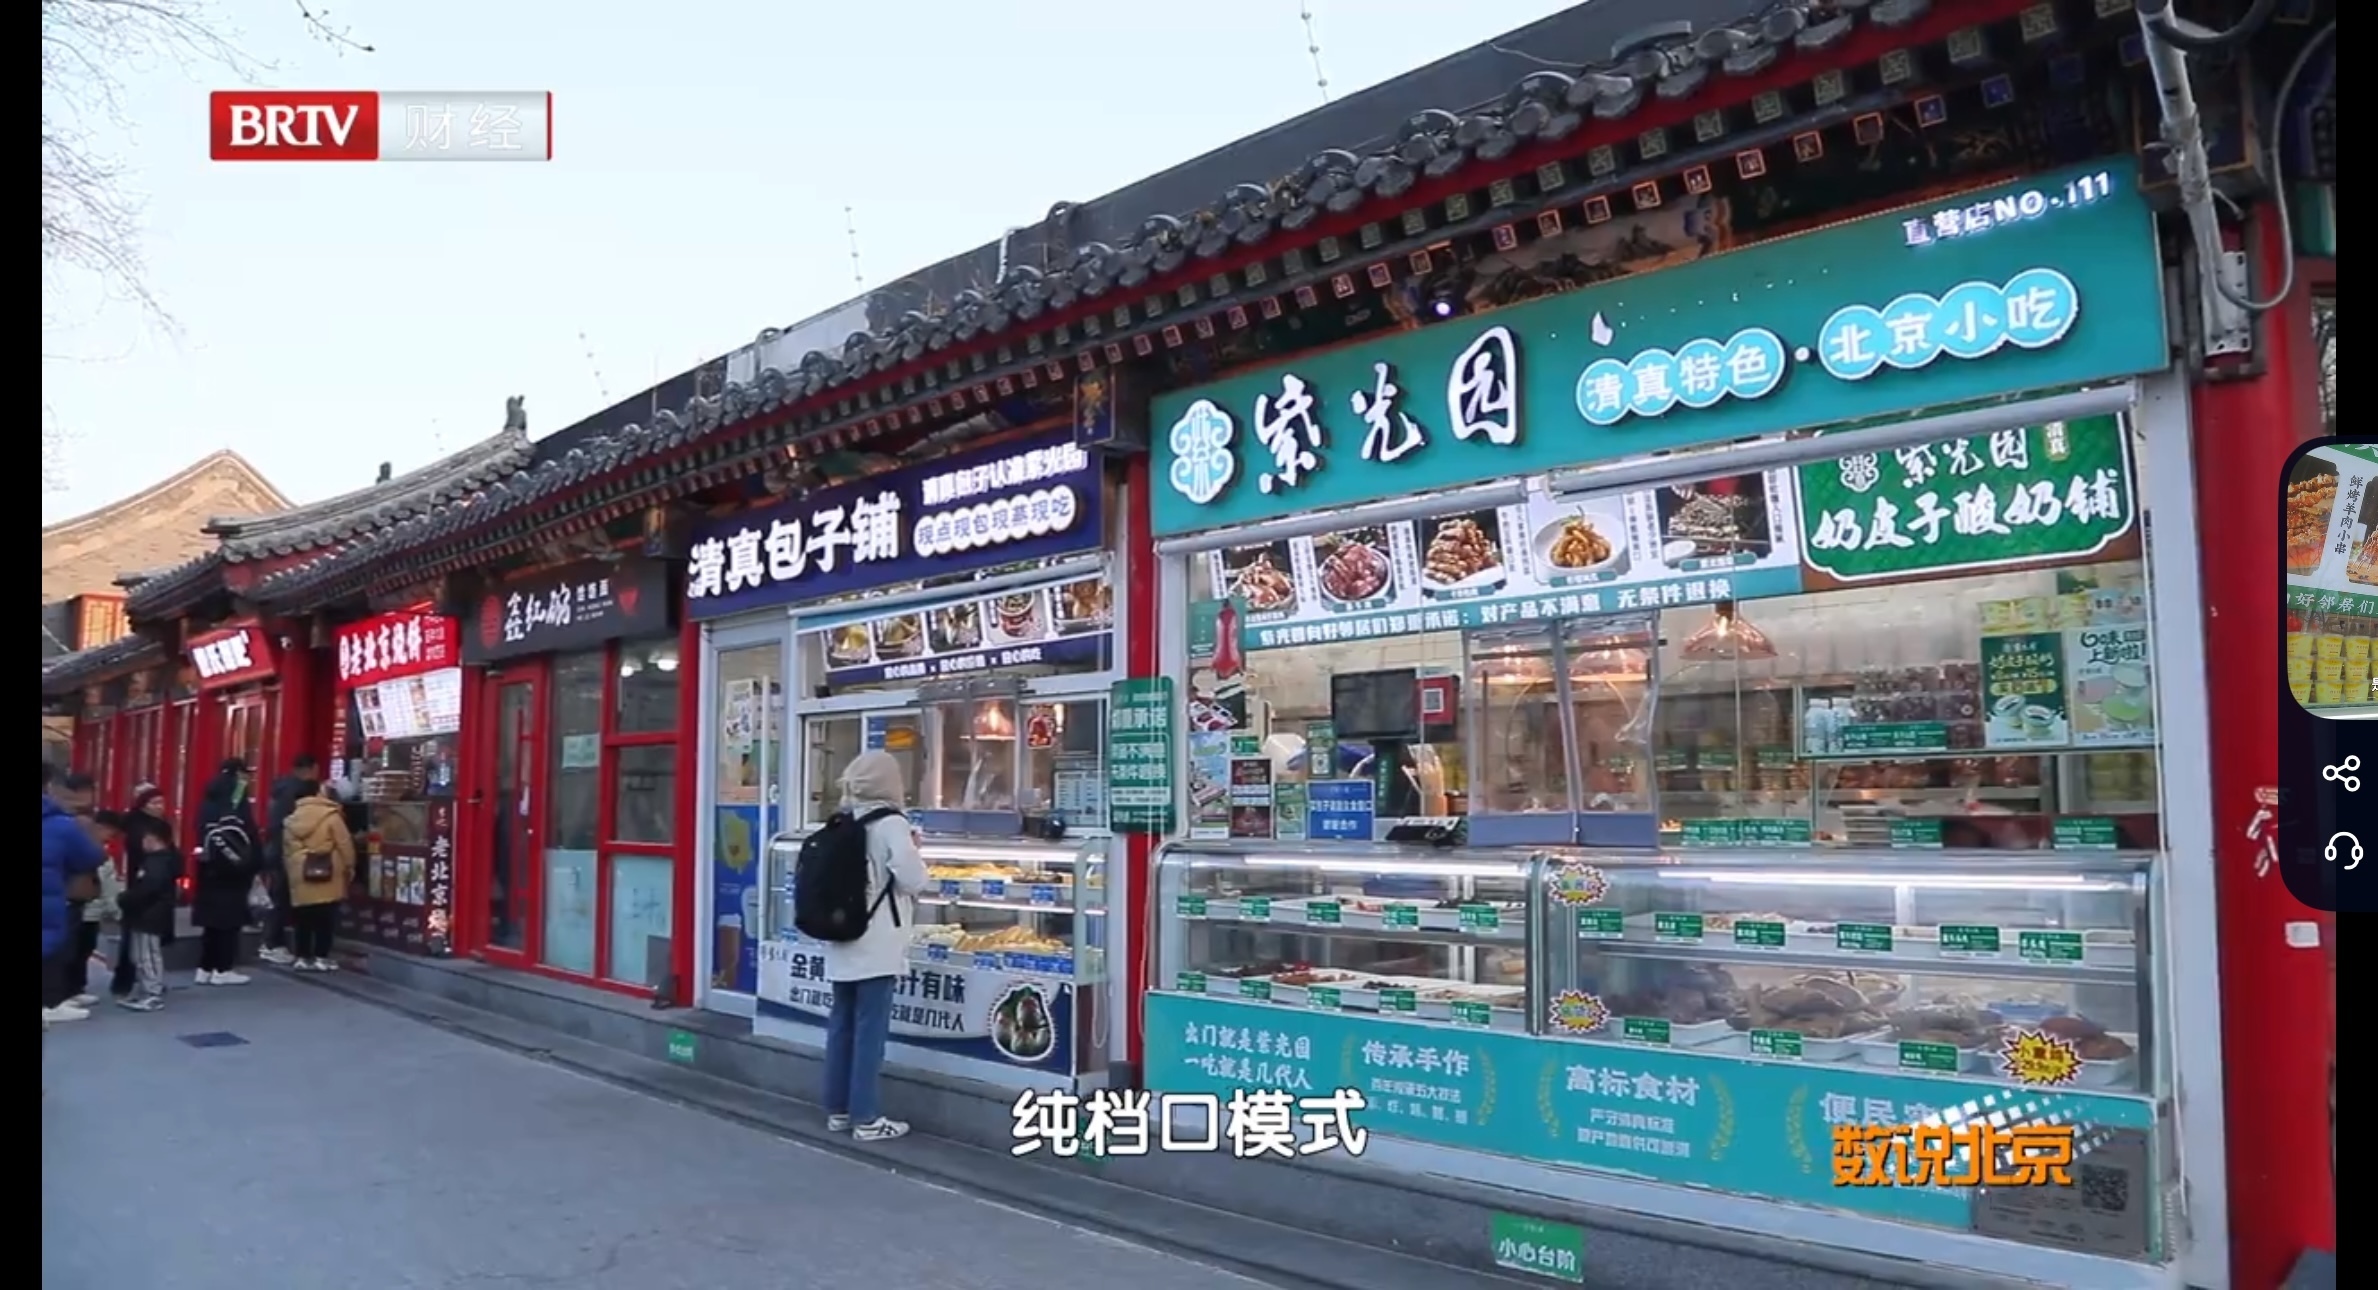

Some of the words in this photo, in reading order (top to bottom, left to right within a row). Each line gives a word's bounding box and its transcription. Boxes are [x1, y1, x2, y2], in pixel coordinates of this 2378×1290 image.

[1255, 326, 1515, 494] 紫光园
[1896, 428, 2029, 487] 紫光园
[917, 495, 1071, 546] 现点现包现蒸现吃
[1811, 469, 2119, 550] 奶皮子酸奶铺
[687, 491, 901, 598] 清真包子铺
[1617, 577, 1732, 609] 无条件退换
[1185, 1022, 1312, 1060] 出门就是紫光园
[1362, 1040, 1470, 1076] 传承手作
[1185, 1055, 1313, 1091] 一吃就是几代人
[1566, 1064, 1700, 1106] 高标食材
[1498, 1237, 1576, 1272] 小心台阶
